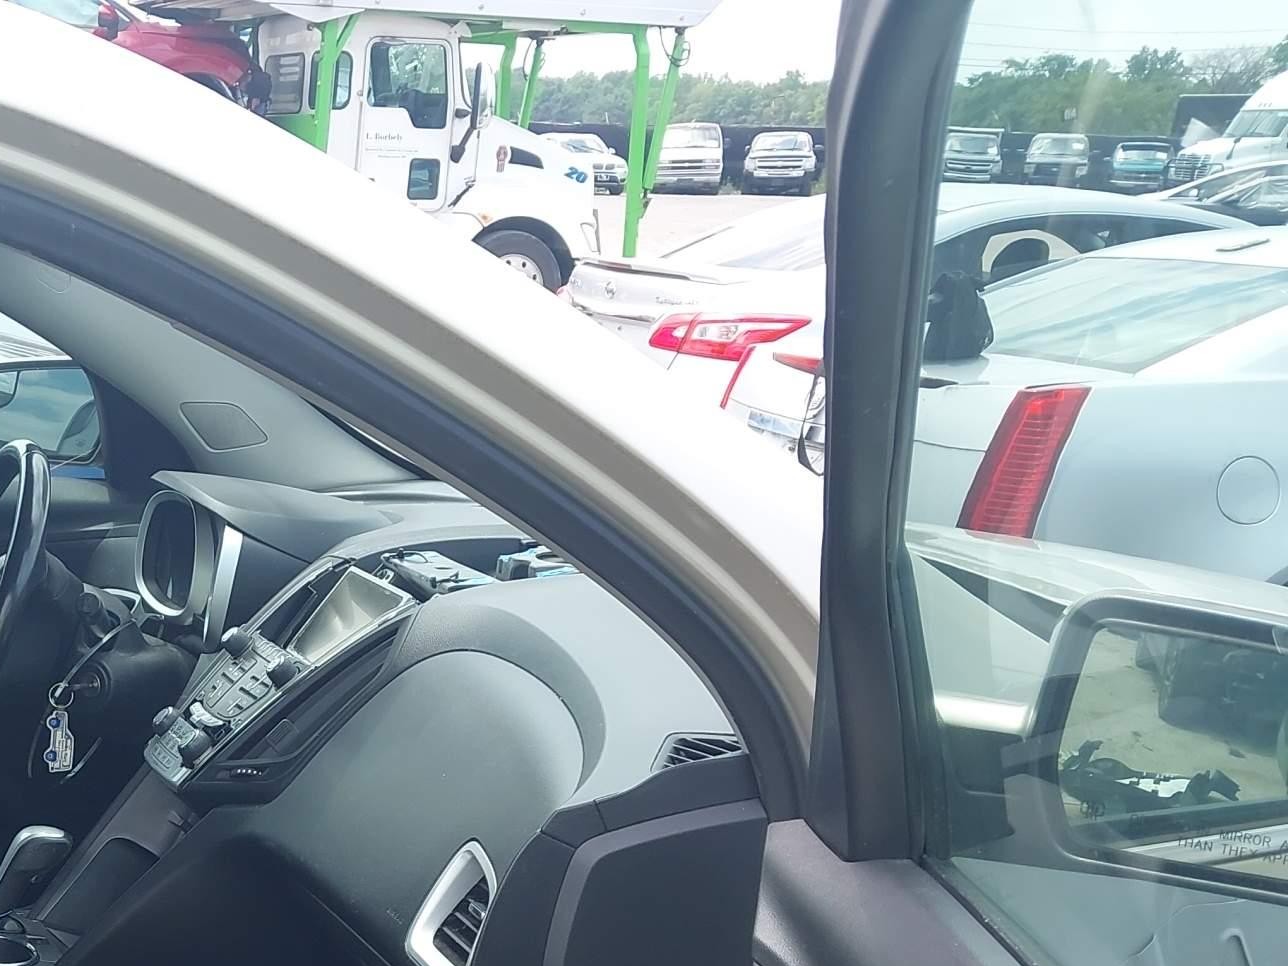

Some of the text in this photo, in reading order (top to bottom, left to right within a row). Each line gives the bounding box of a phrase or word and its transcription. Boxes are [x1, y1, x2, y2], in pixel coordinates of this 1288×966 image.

[564, 166, 589, 183] 20
[1176, 837, 1214, 852] THAN
[1219, 830, 1272, 848] MIRROR
